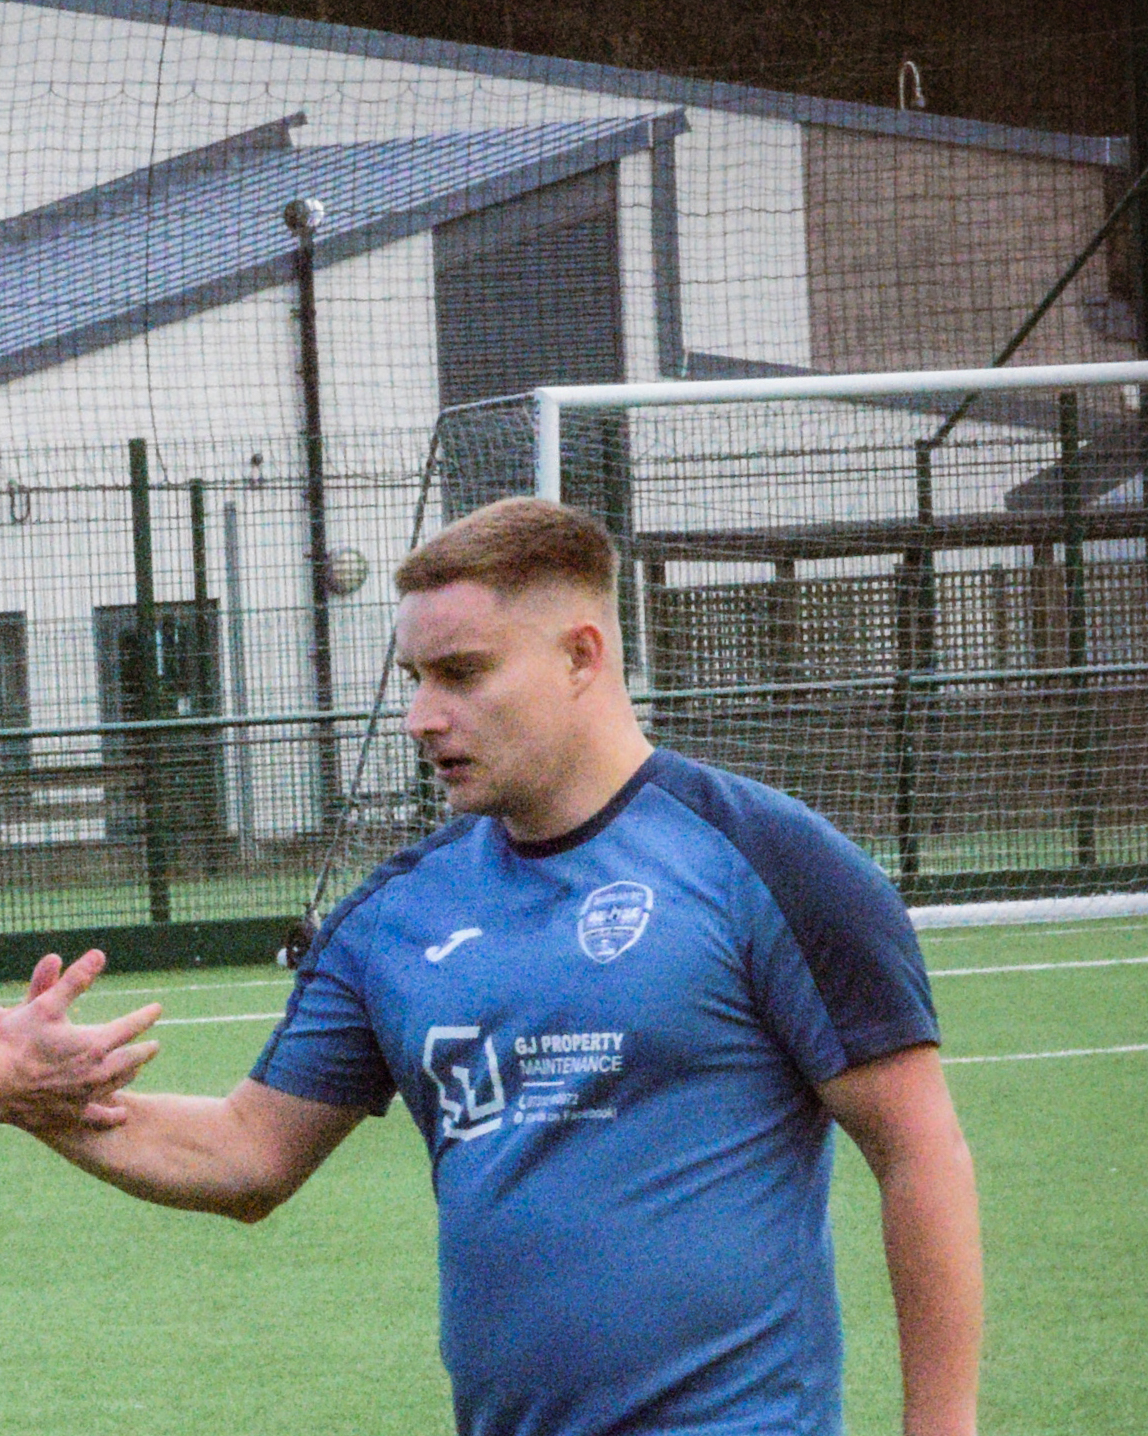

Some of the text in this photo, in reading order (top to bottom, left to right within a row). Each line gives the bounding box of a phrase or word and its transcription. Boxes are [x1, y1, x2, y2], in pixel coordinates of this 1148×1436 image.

[514, 1032, 624, 1055] GJ PROPERTY
[519, 1055, 622, 1075] MAINTENANCE
